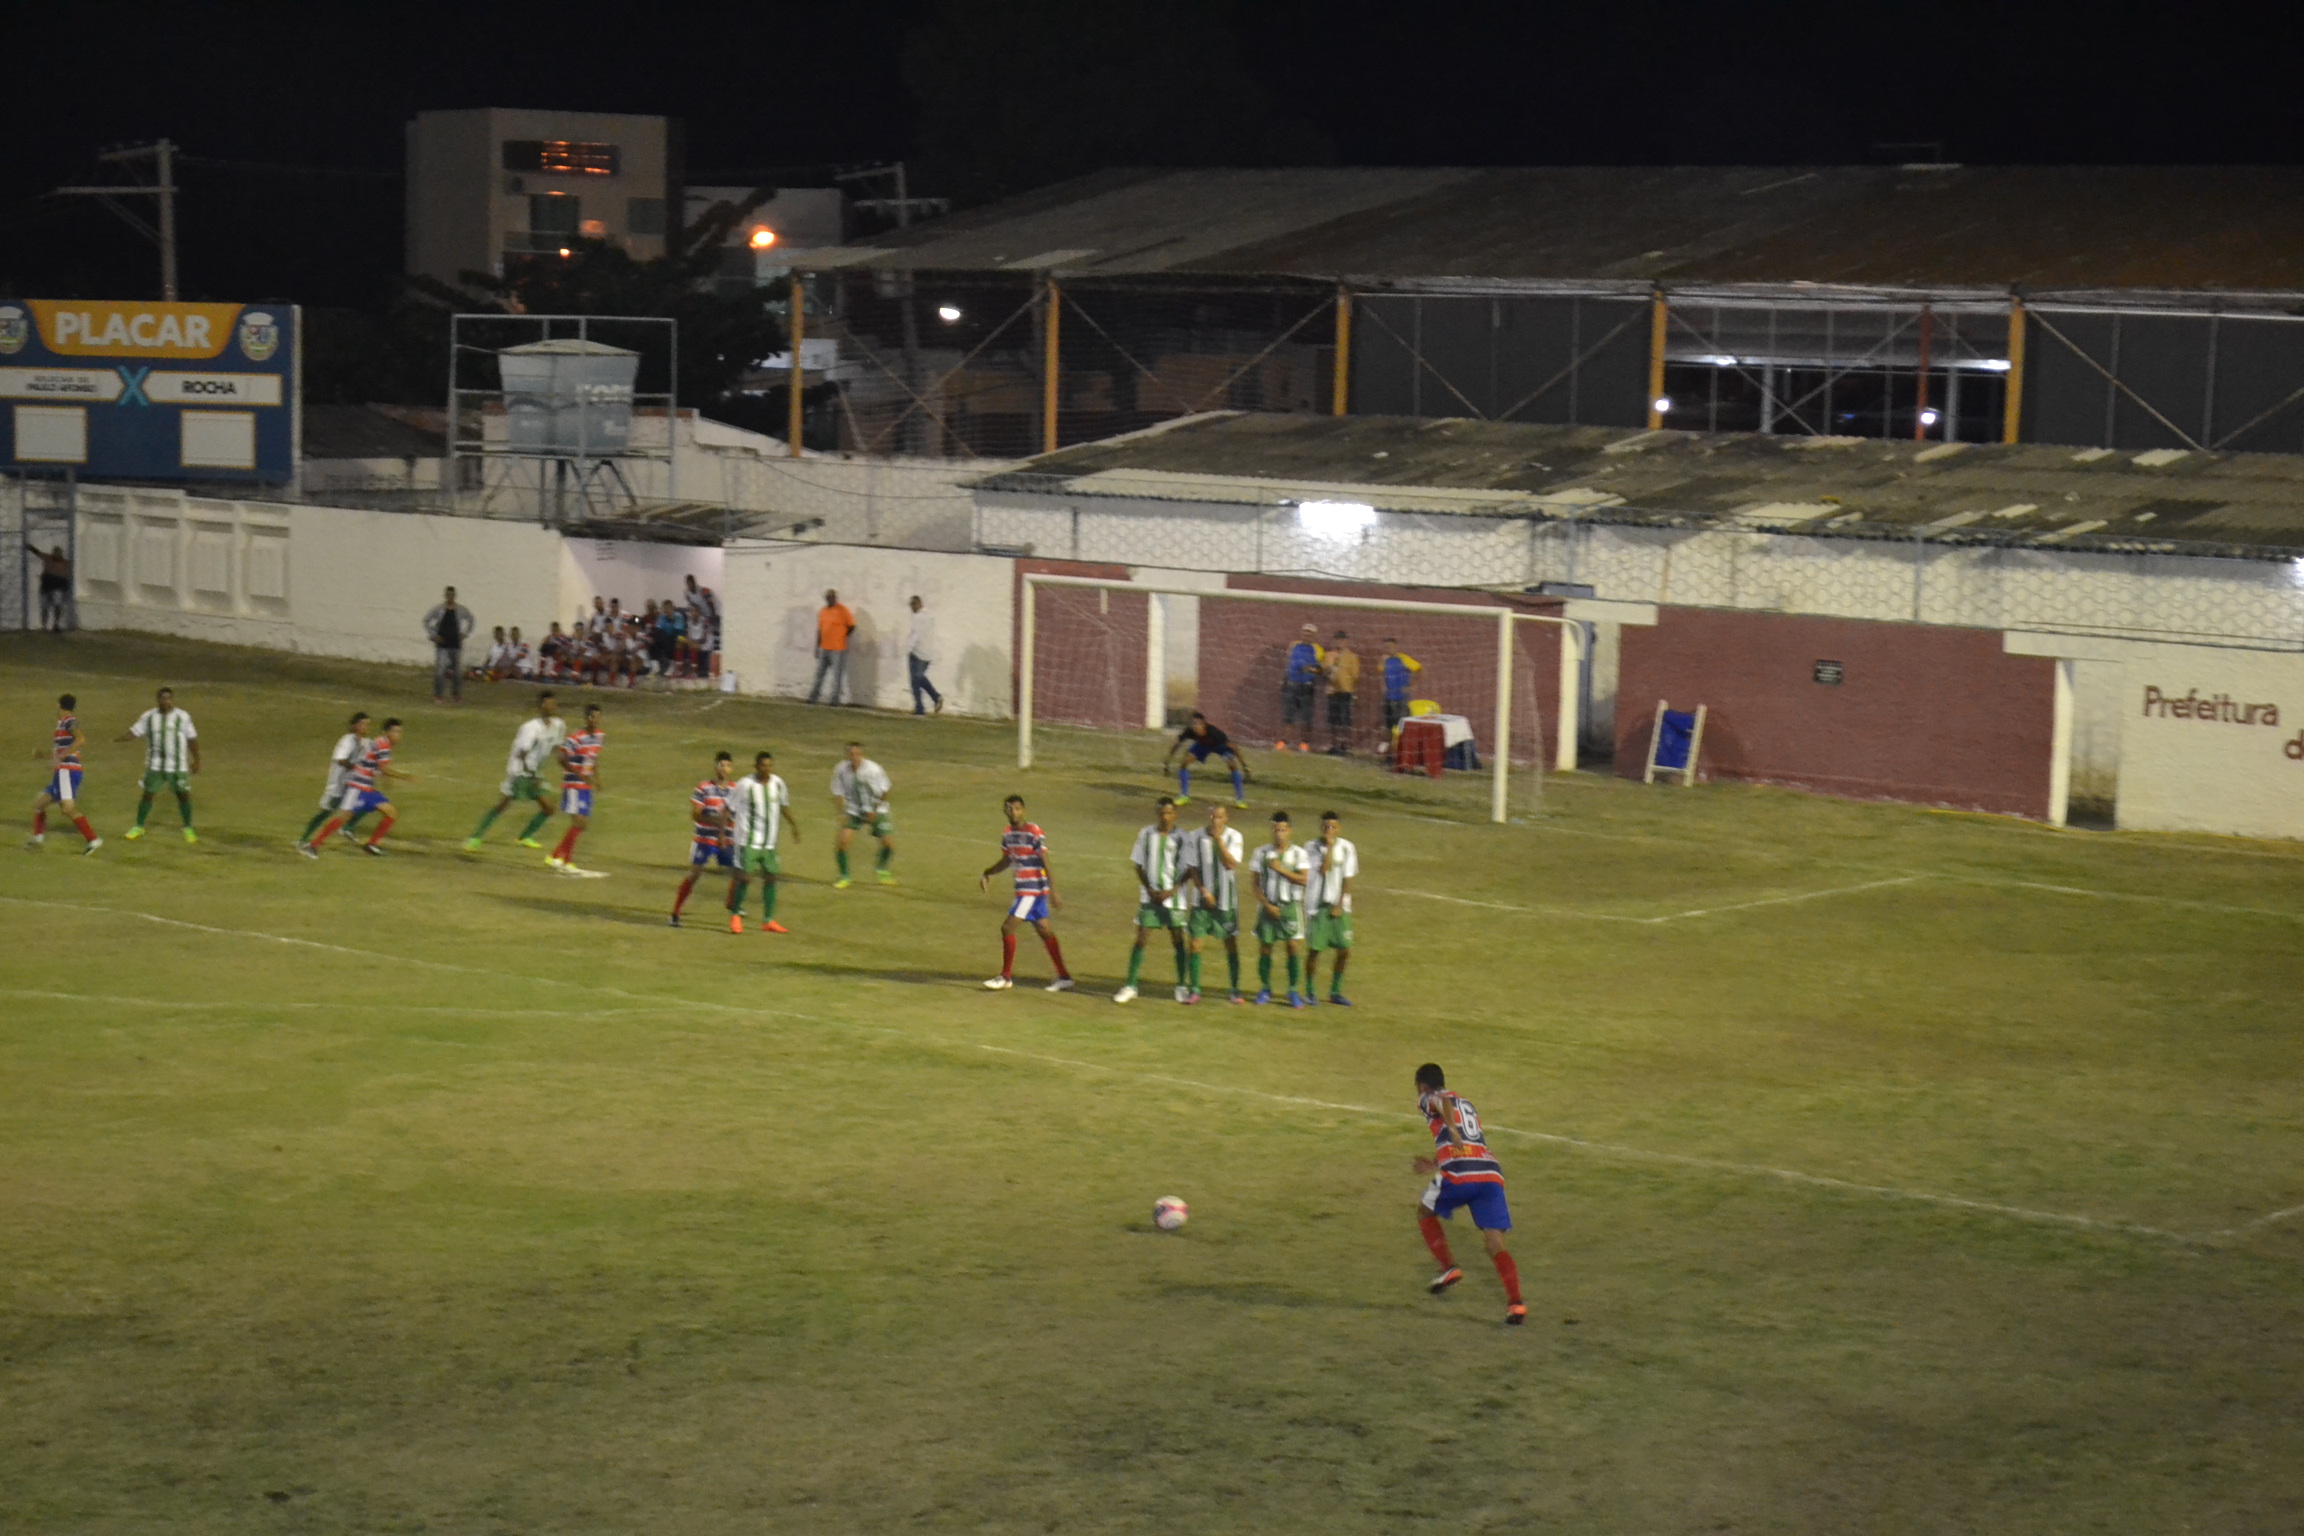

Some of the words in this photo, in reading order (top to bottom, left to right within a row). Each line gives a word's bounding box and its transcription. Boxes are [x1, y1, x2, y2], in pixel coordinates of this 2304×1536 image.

[55, 311, 212, 349] PLACAR
[117, 365, 149, 406] X
[182, 380, 236, 395] ROCHA
[2143, 684, 2279, 727] Prefeitura
